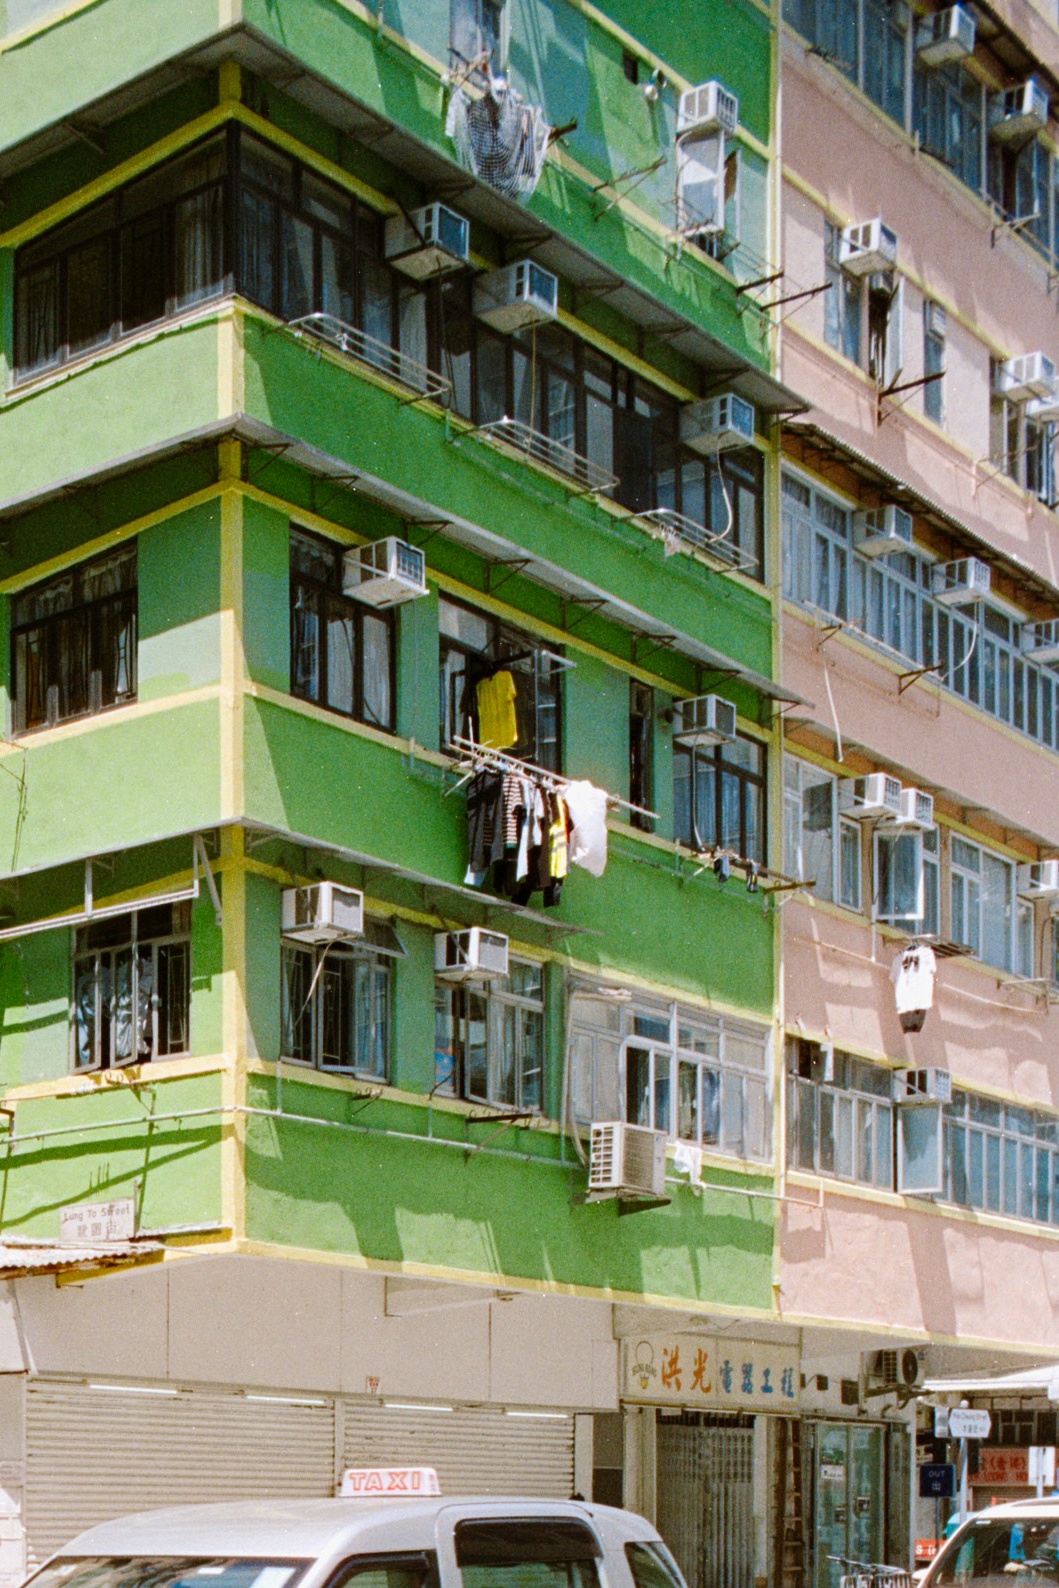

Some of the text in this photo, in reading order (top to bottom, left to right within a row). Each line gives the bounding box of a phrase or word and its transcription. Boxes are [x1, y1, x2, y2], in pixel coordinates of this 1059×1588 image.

[63, 1203, 130, 1222] Lung To Street
[661, 1344, 795, 1398] 洪光 電器工程
[348, 1471, 421, 1492] TAXI
[928, 1470, 946, 1478] OUT
[931, 1481, 942, 1492] 出
